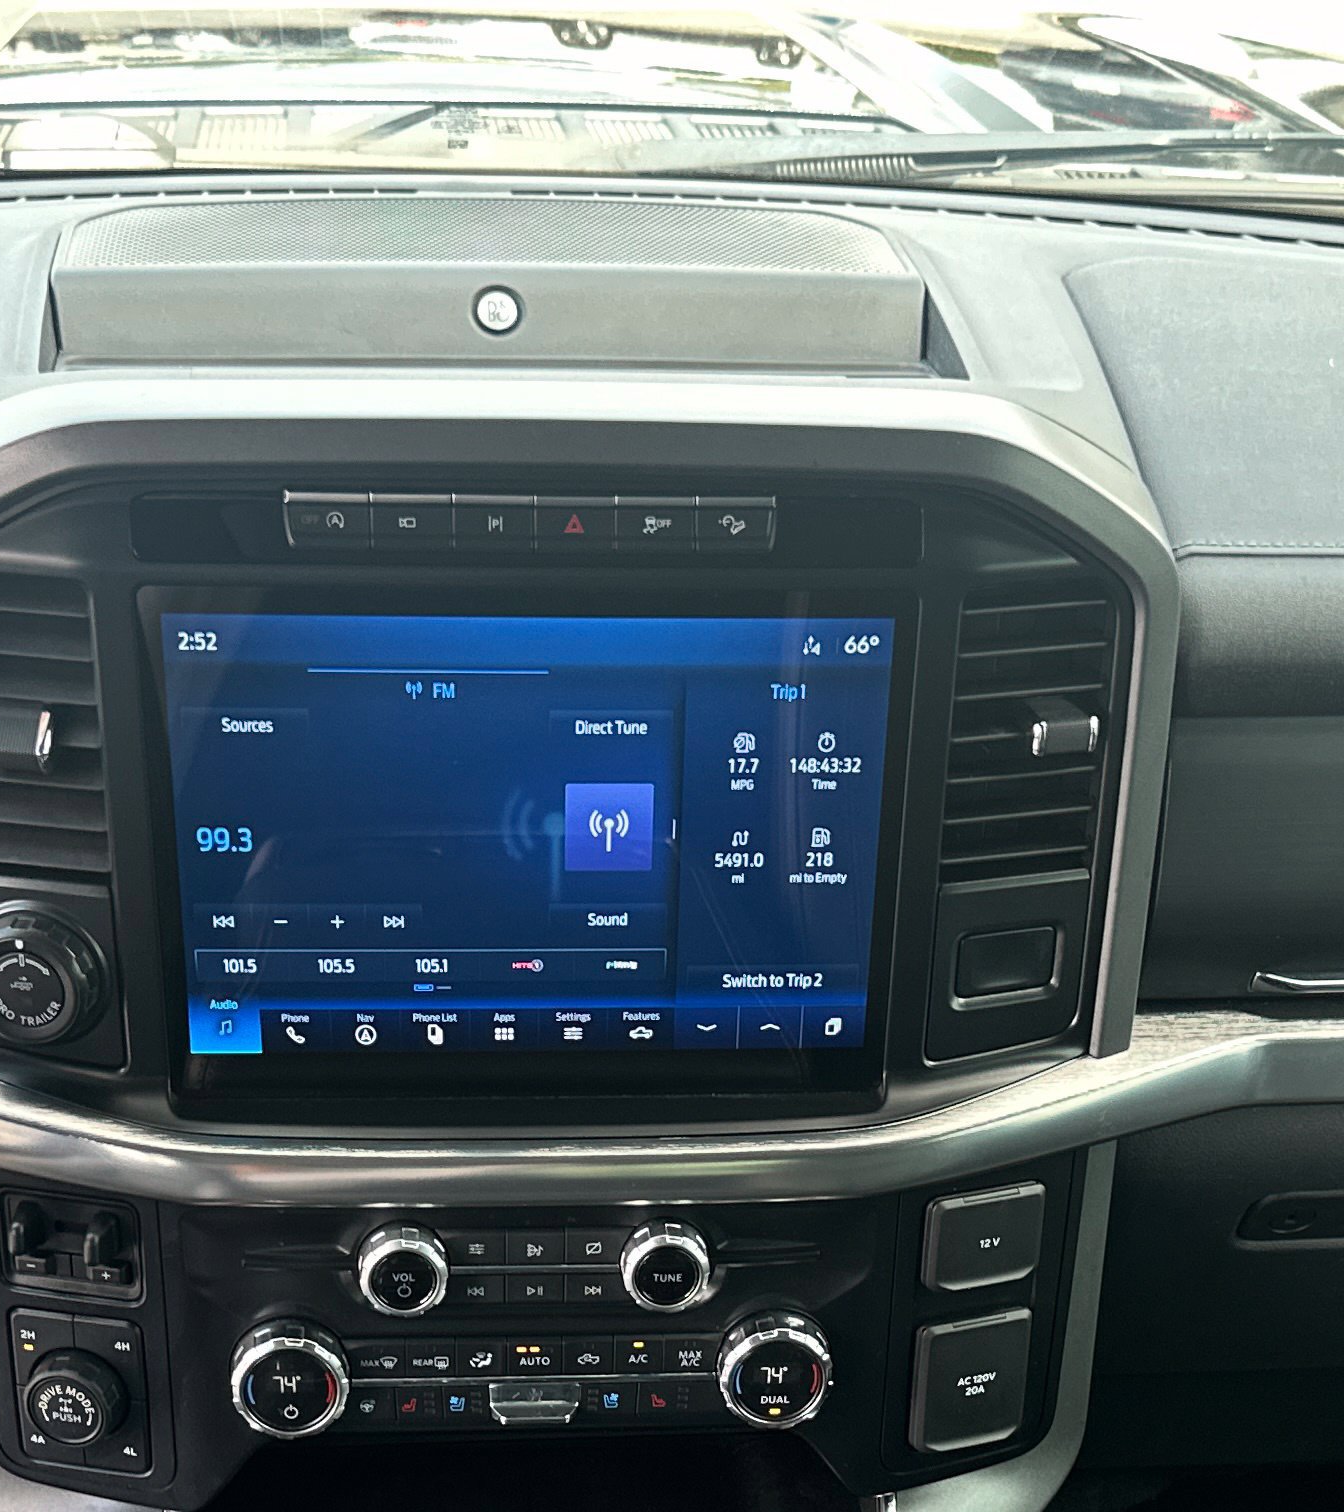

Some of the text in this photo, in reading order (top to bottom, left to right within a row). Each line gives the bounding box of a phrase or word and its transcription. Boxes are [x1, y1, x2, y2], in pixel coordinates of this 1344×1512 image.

[177, 631, 218, 651] 2:52
[432, 681, 456, 699] FM
[769, 683, 807, 703] Trip 1
[221, 716, 274, 733] Sources
[574, 719, 648, 735] Direct Tune
[727, 757, 760, 774] 17.7
[789, 757, 862, 774] 148:43:32
[730, 778, 755, 791] MPG
[811, 777, 838, 790] Time
[195, 826, 253, 853] 99.3
[714, 852, 764, 868] 5491.0
[805, 851, 834, 867] 218
[731, 872, 745, 884] mi
[789, 871, 848, 885] mi to Empty
[587, 911, 629, 927] Sound
[222, 958, 258, 974] 101.5
[317, 958, 356, 974] 105.5
[415, 958, 449, 974] 105.1
[721, 972, 823, 990] Switch to Trip 2
[209, 999, 239, 1011] Audio
[19, 1000, 62, 1027] TRAILER
[280, 1013, 310, 1023] Phone
[356, 1013, 375, 1023] Nav
[412, 1012, 458, 1023] Phone List
[493, 1012, 516, 1024] Apps
[555, 1011, 592, 1024] Settings
[622, 1011, 661, 1022] Features
[979, 1236, 1001, 1249] 12 V
[391, 1272, 416, 1283] VOL
[652, 1273, 683, 1284] TUNE
[19, 1329, 36, 1340] 2H
[114, 1341, 131, 1351] 4H
[519, 1355, 551, 1366] AUTO
[628, 1353, 649, 1364] A/C
[678, 1350, 703, 1360] MAX
[360, 1359, 380, 1368] MAX
[412, 1358, 434, 1367] REAR
[680, 1358, 701, 1368] A/C
[957, 1371, 997, 1387] AC 120V
[964, 1384, 986, 1397] 20A
[38, 1384, 96, 1415] DRIVE MODE
[759, 1395, 791, 1405] DUAL
[52, 1411, 82, 1423] PUSH
[29, 1433, 46, 1445] 4A
[123, 1446, 138, 1457] 4L
